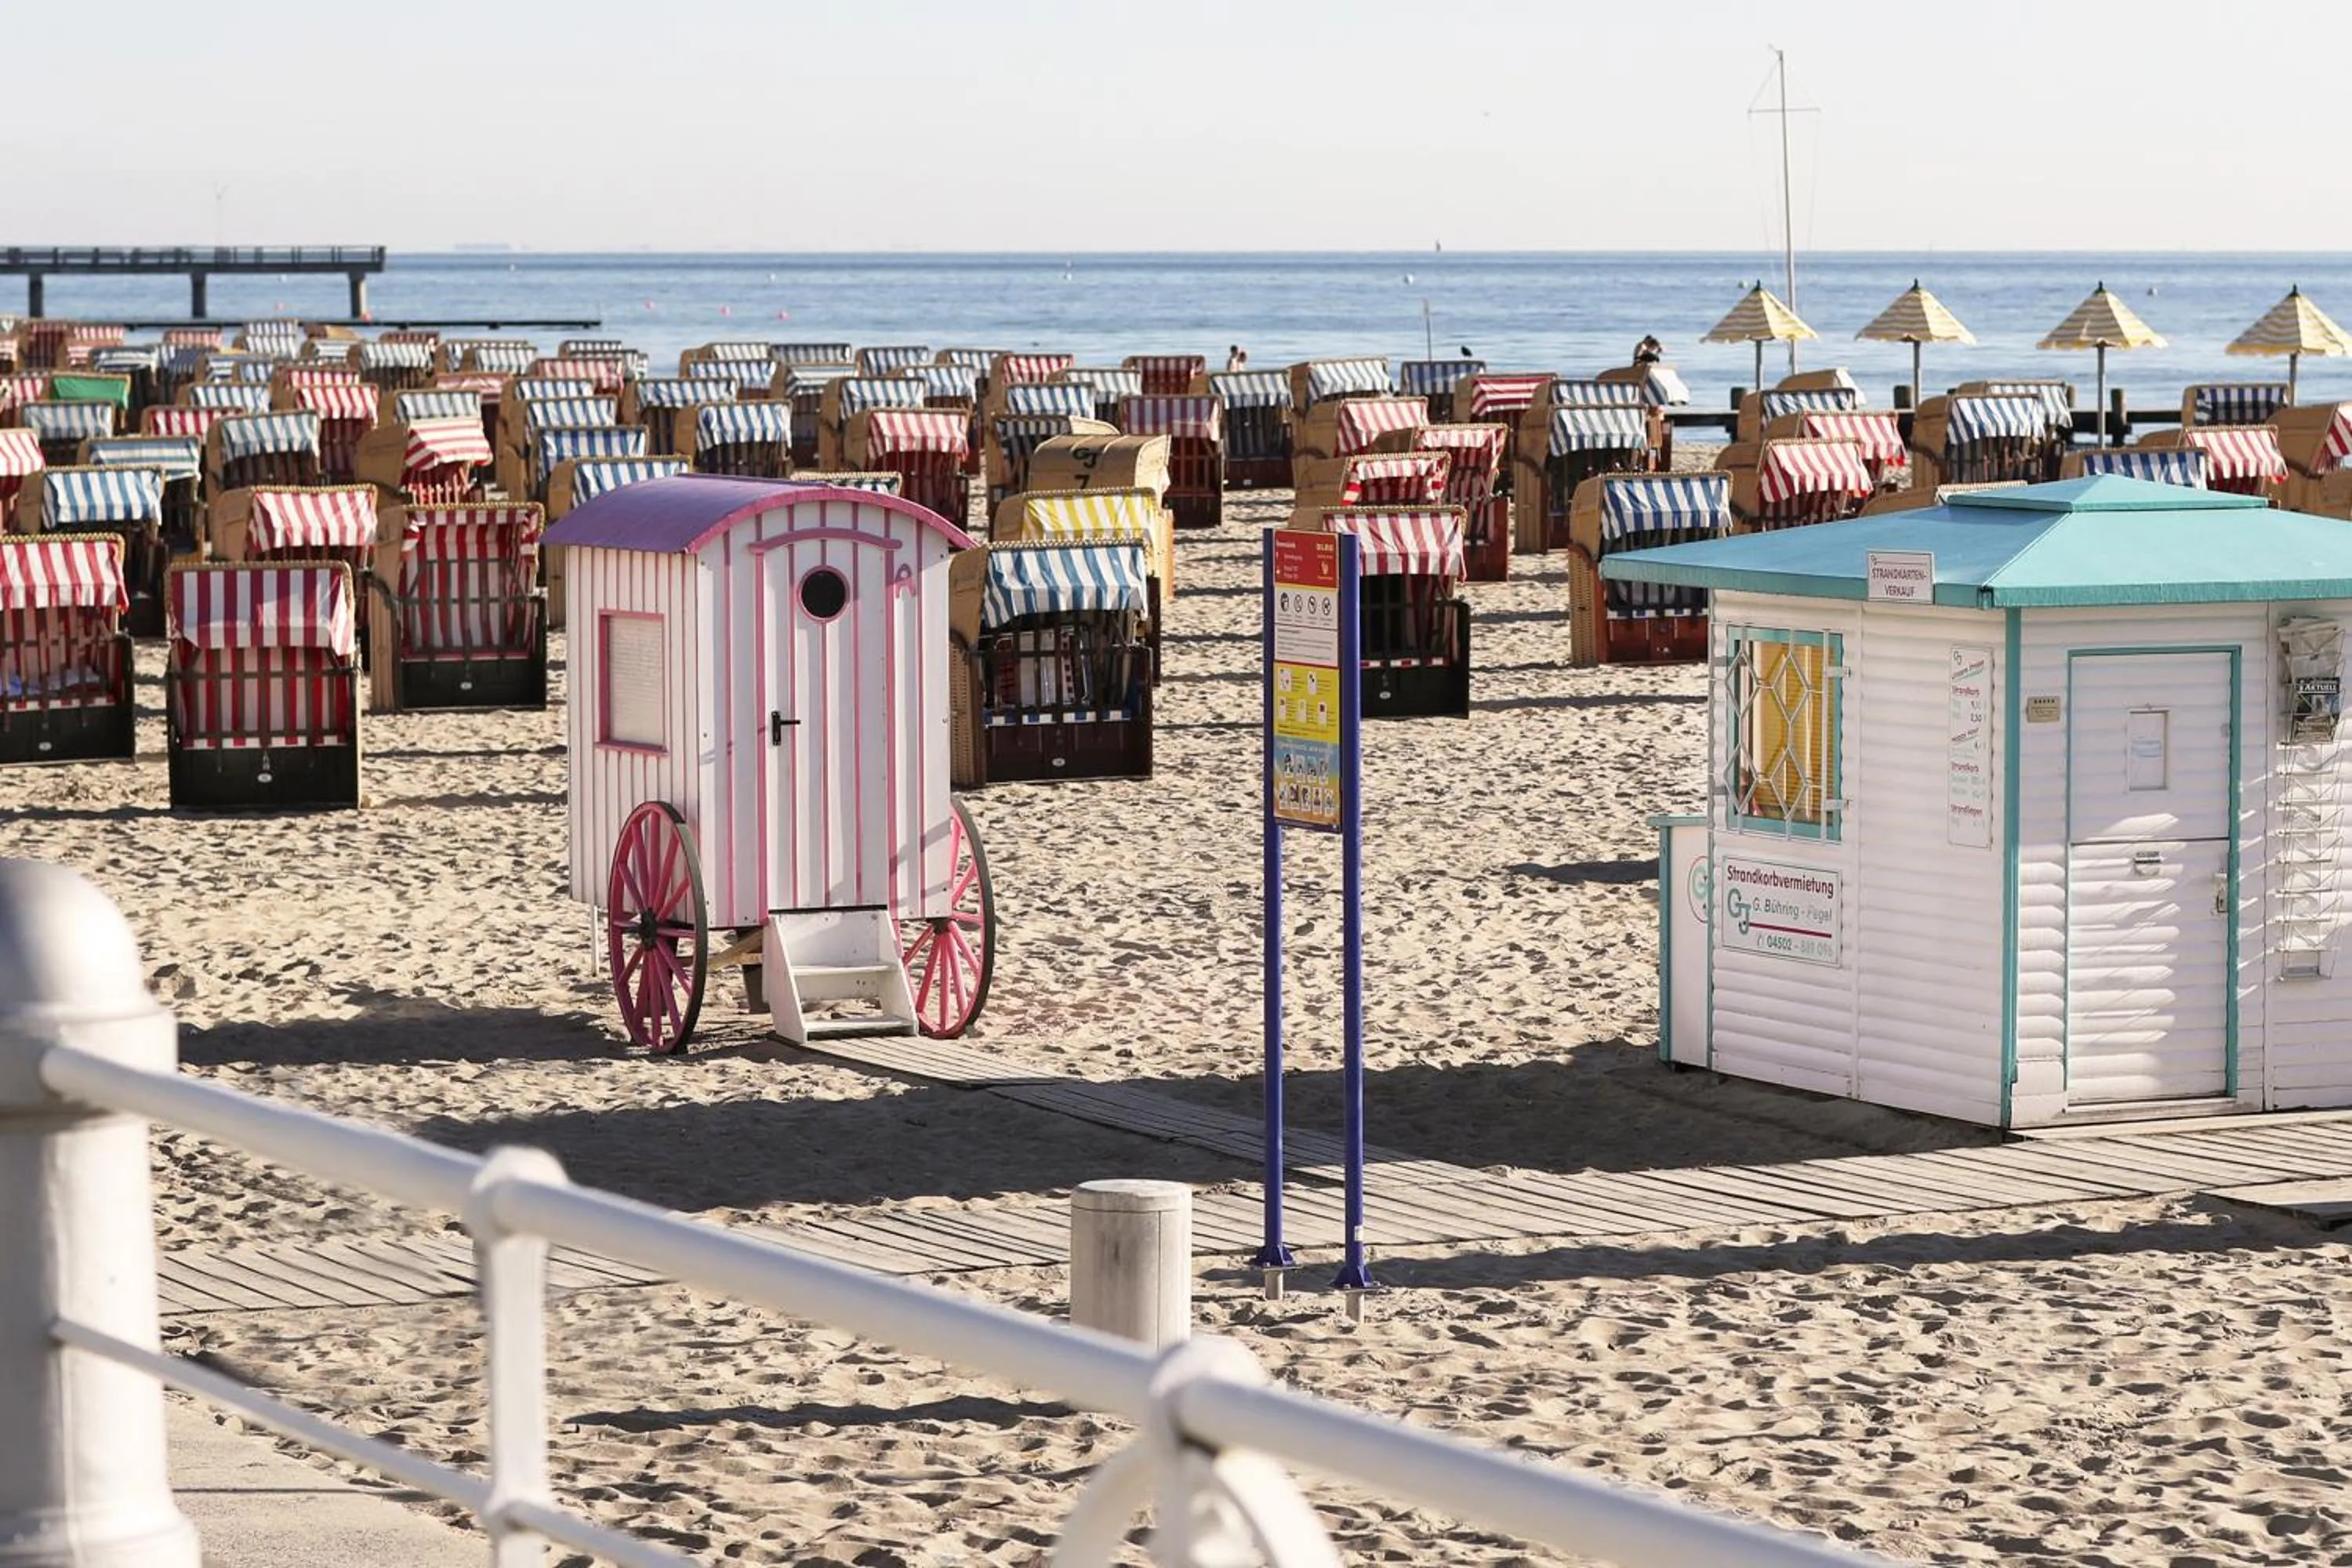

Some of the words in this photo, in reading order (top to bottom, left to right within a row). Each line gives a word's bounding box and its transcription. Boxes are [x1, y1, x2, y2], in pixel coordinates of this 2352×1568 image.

[1727, 865, 1834, 899] Strandkorbvermietung
[1764, 898, 1799, 920] Bühring
[1766, 935, 1791, 951] 04502
